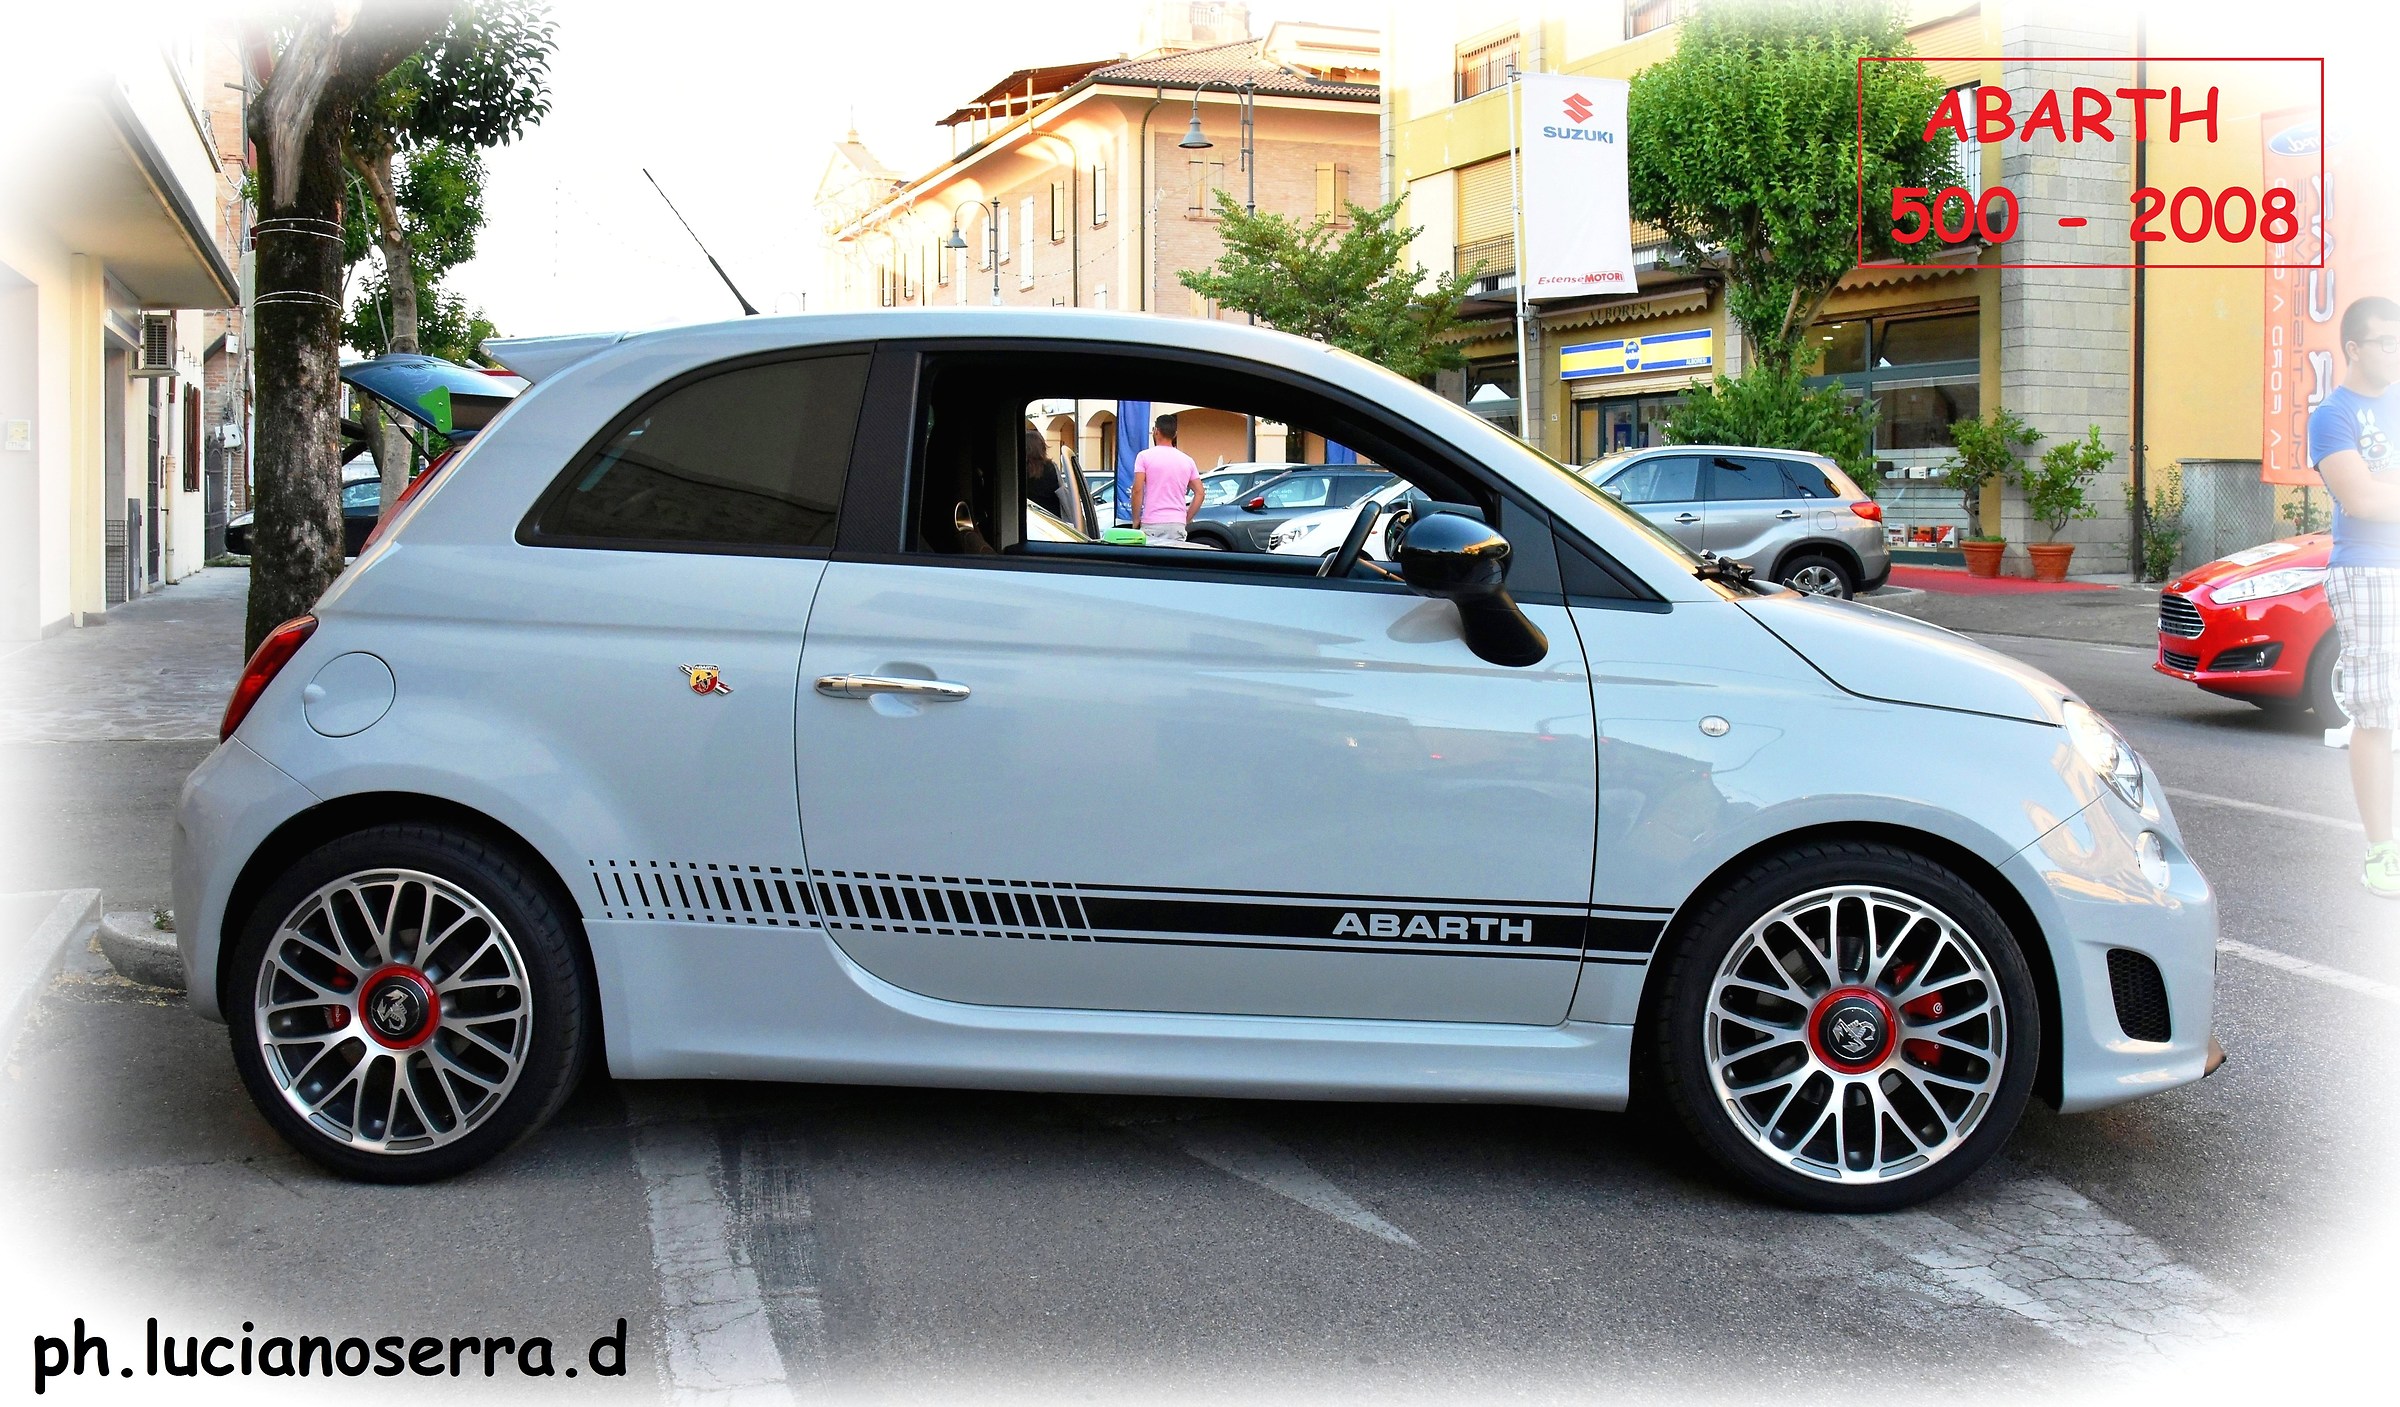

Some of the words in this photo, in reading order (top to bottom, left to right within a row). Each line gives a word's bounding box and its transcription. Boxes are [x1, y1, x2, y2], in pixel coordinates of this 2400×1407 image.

[1543, 126, 1614, 144] SUZUKI
[1587, 301, 1651, 322] ALBORESI
[1332, 912, 1532, 942] ABARTH
